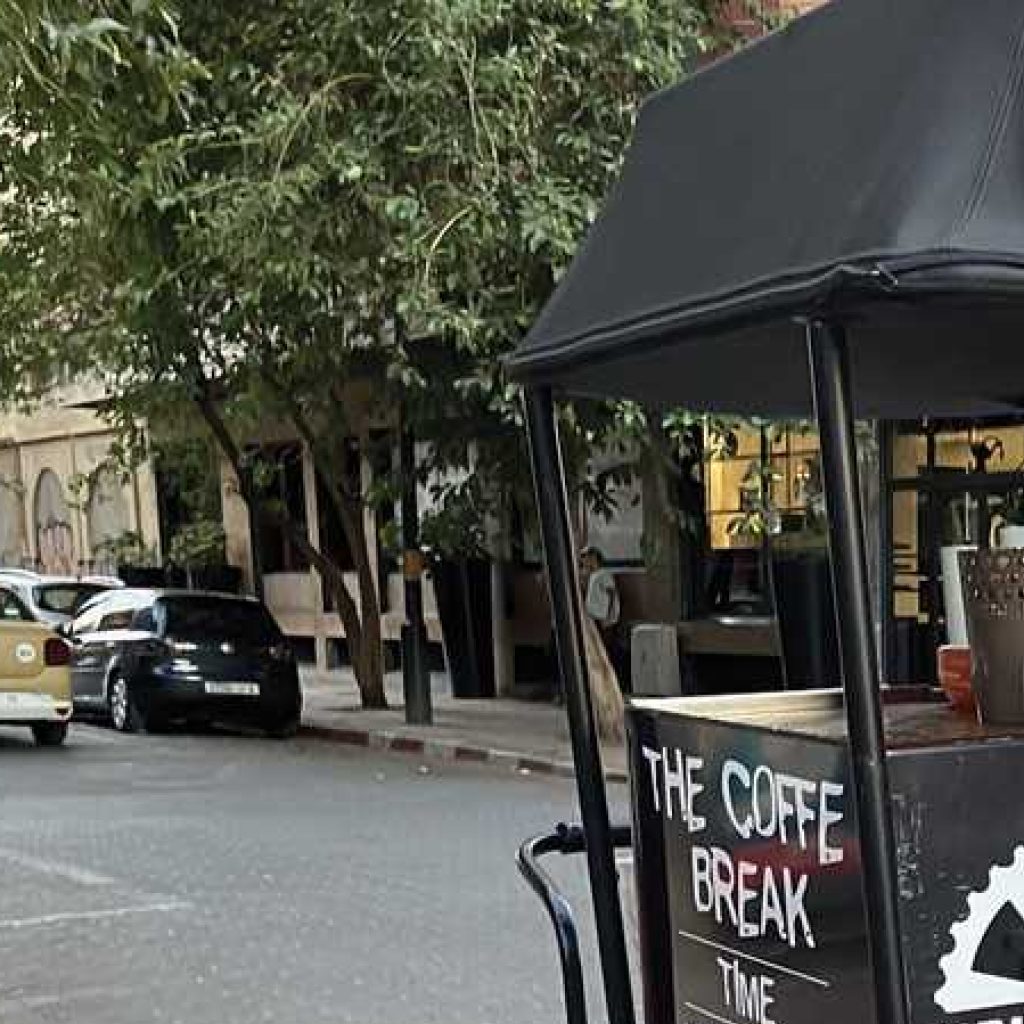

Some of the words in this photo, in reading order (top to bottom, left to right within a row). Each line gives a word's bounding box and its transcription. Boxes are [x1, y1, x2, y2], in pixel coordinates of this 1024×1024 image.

[641, 744, 707, 833] THE
[721, 759, 844, 866] COFFE
[691, 845, 817, 949] BREAK
